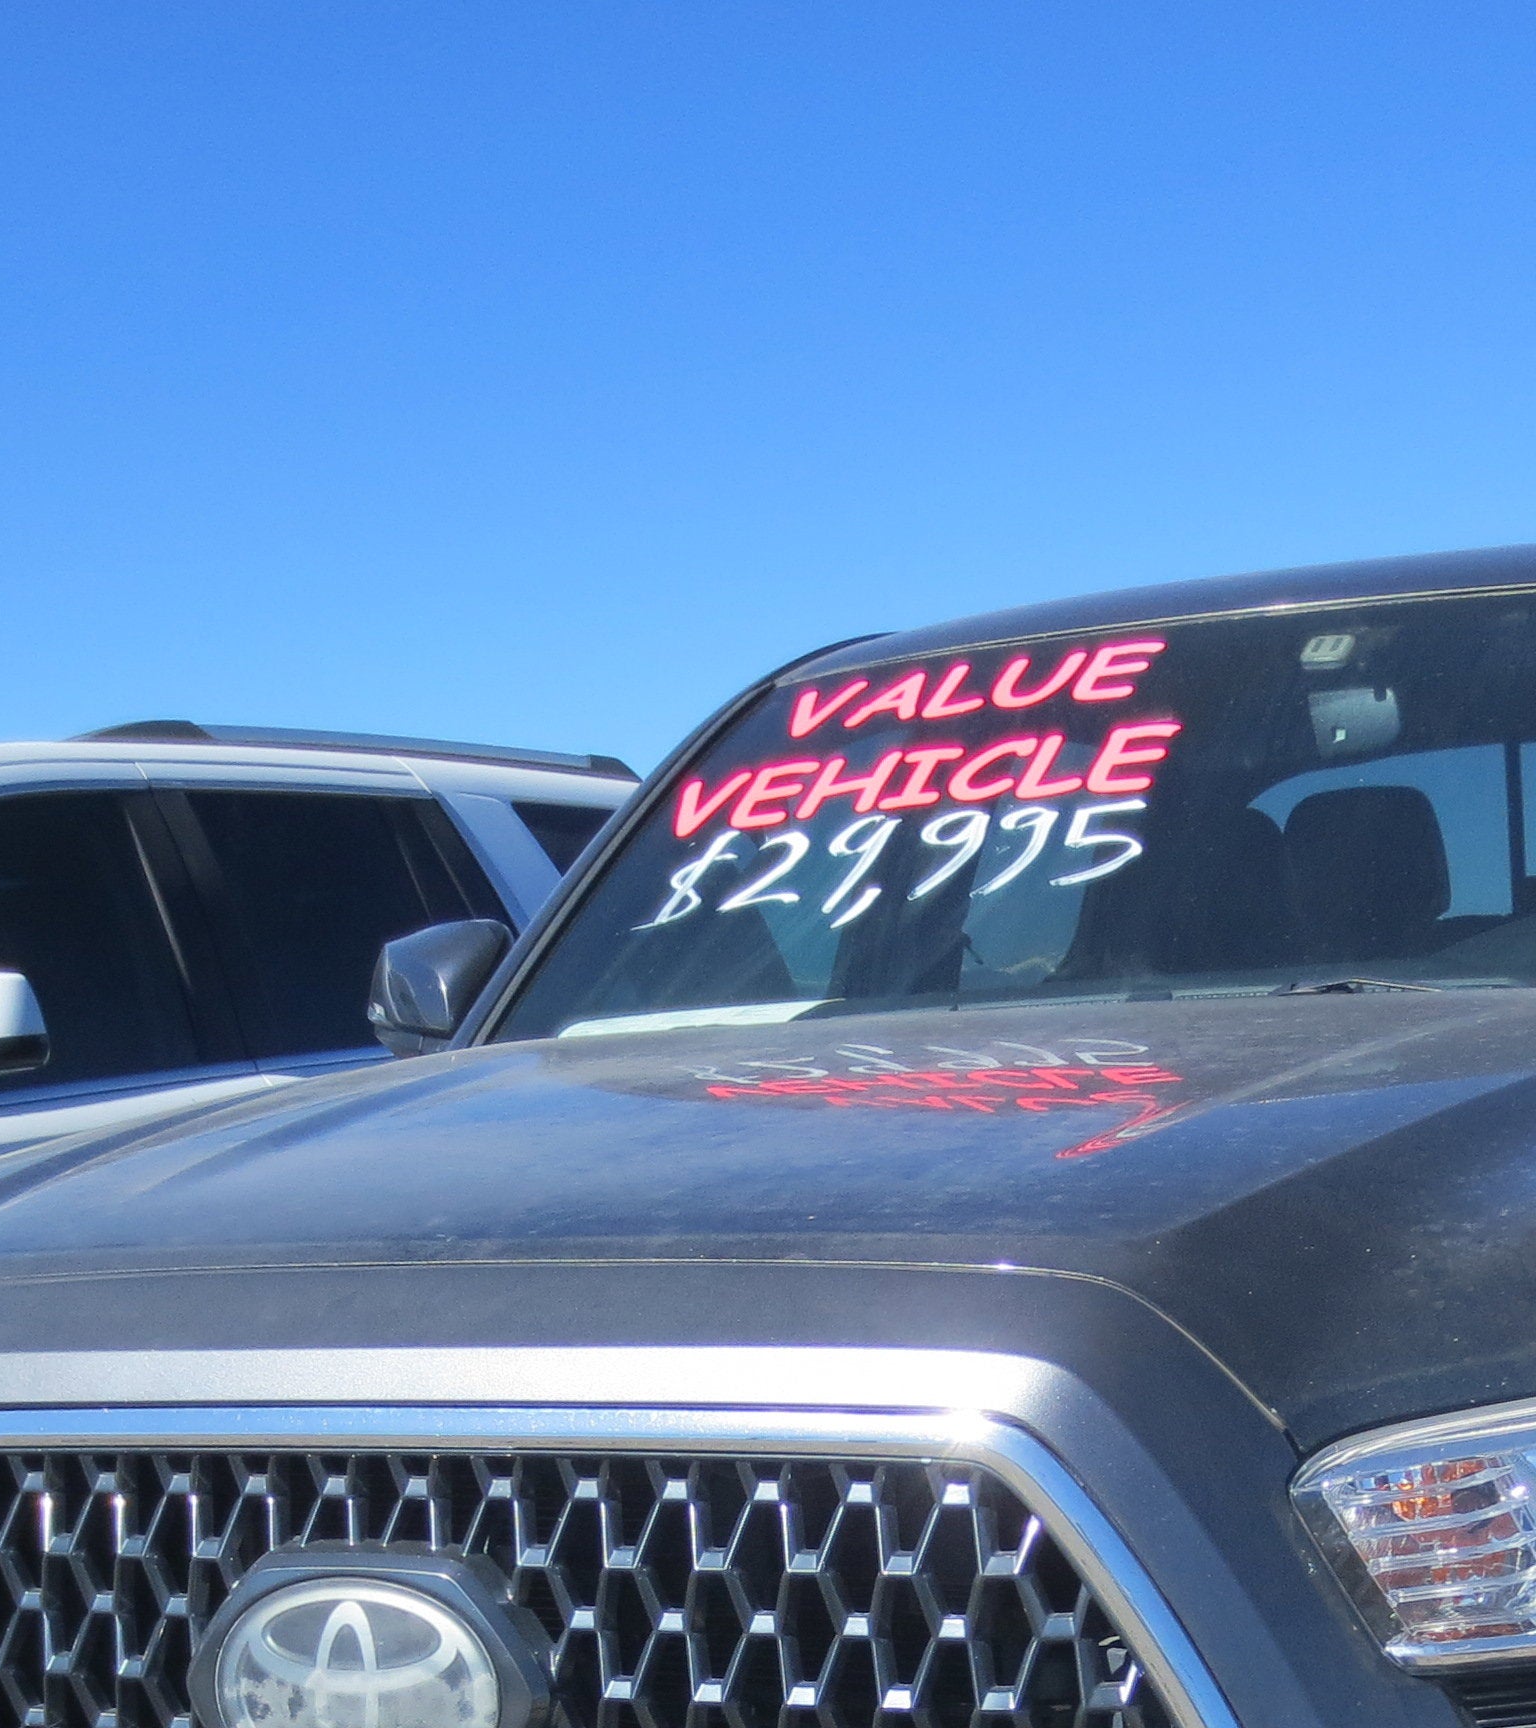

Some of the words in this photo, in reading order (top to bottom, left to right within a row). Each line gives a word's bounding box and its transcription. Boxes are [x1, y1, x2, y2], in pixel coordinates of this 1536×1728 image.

[787, 639, 1168, 739] VALUE
[673, 721, 1184, 839] VEHICLE
[631, 799, 1148, 931] $29,995
